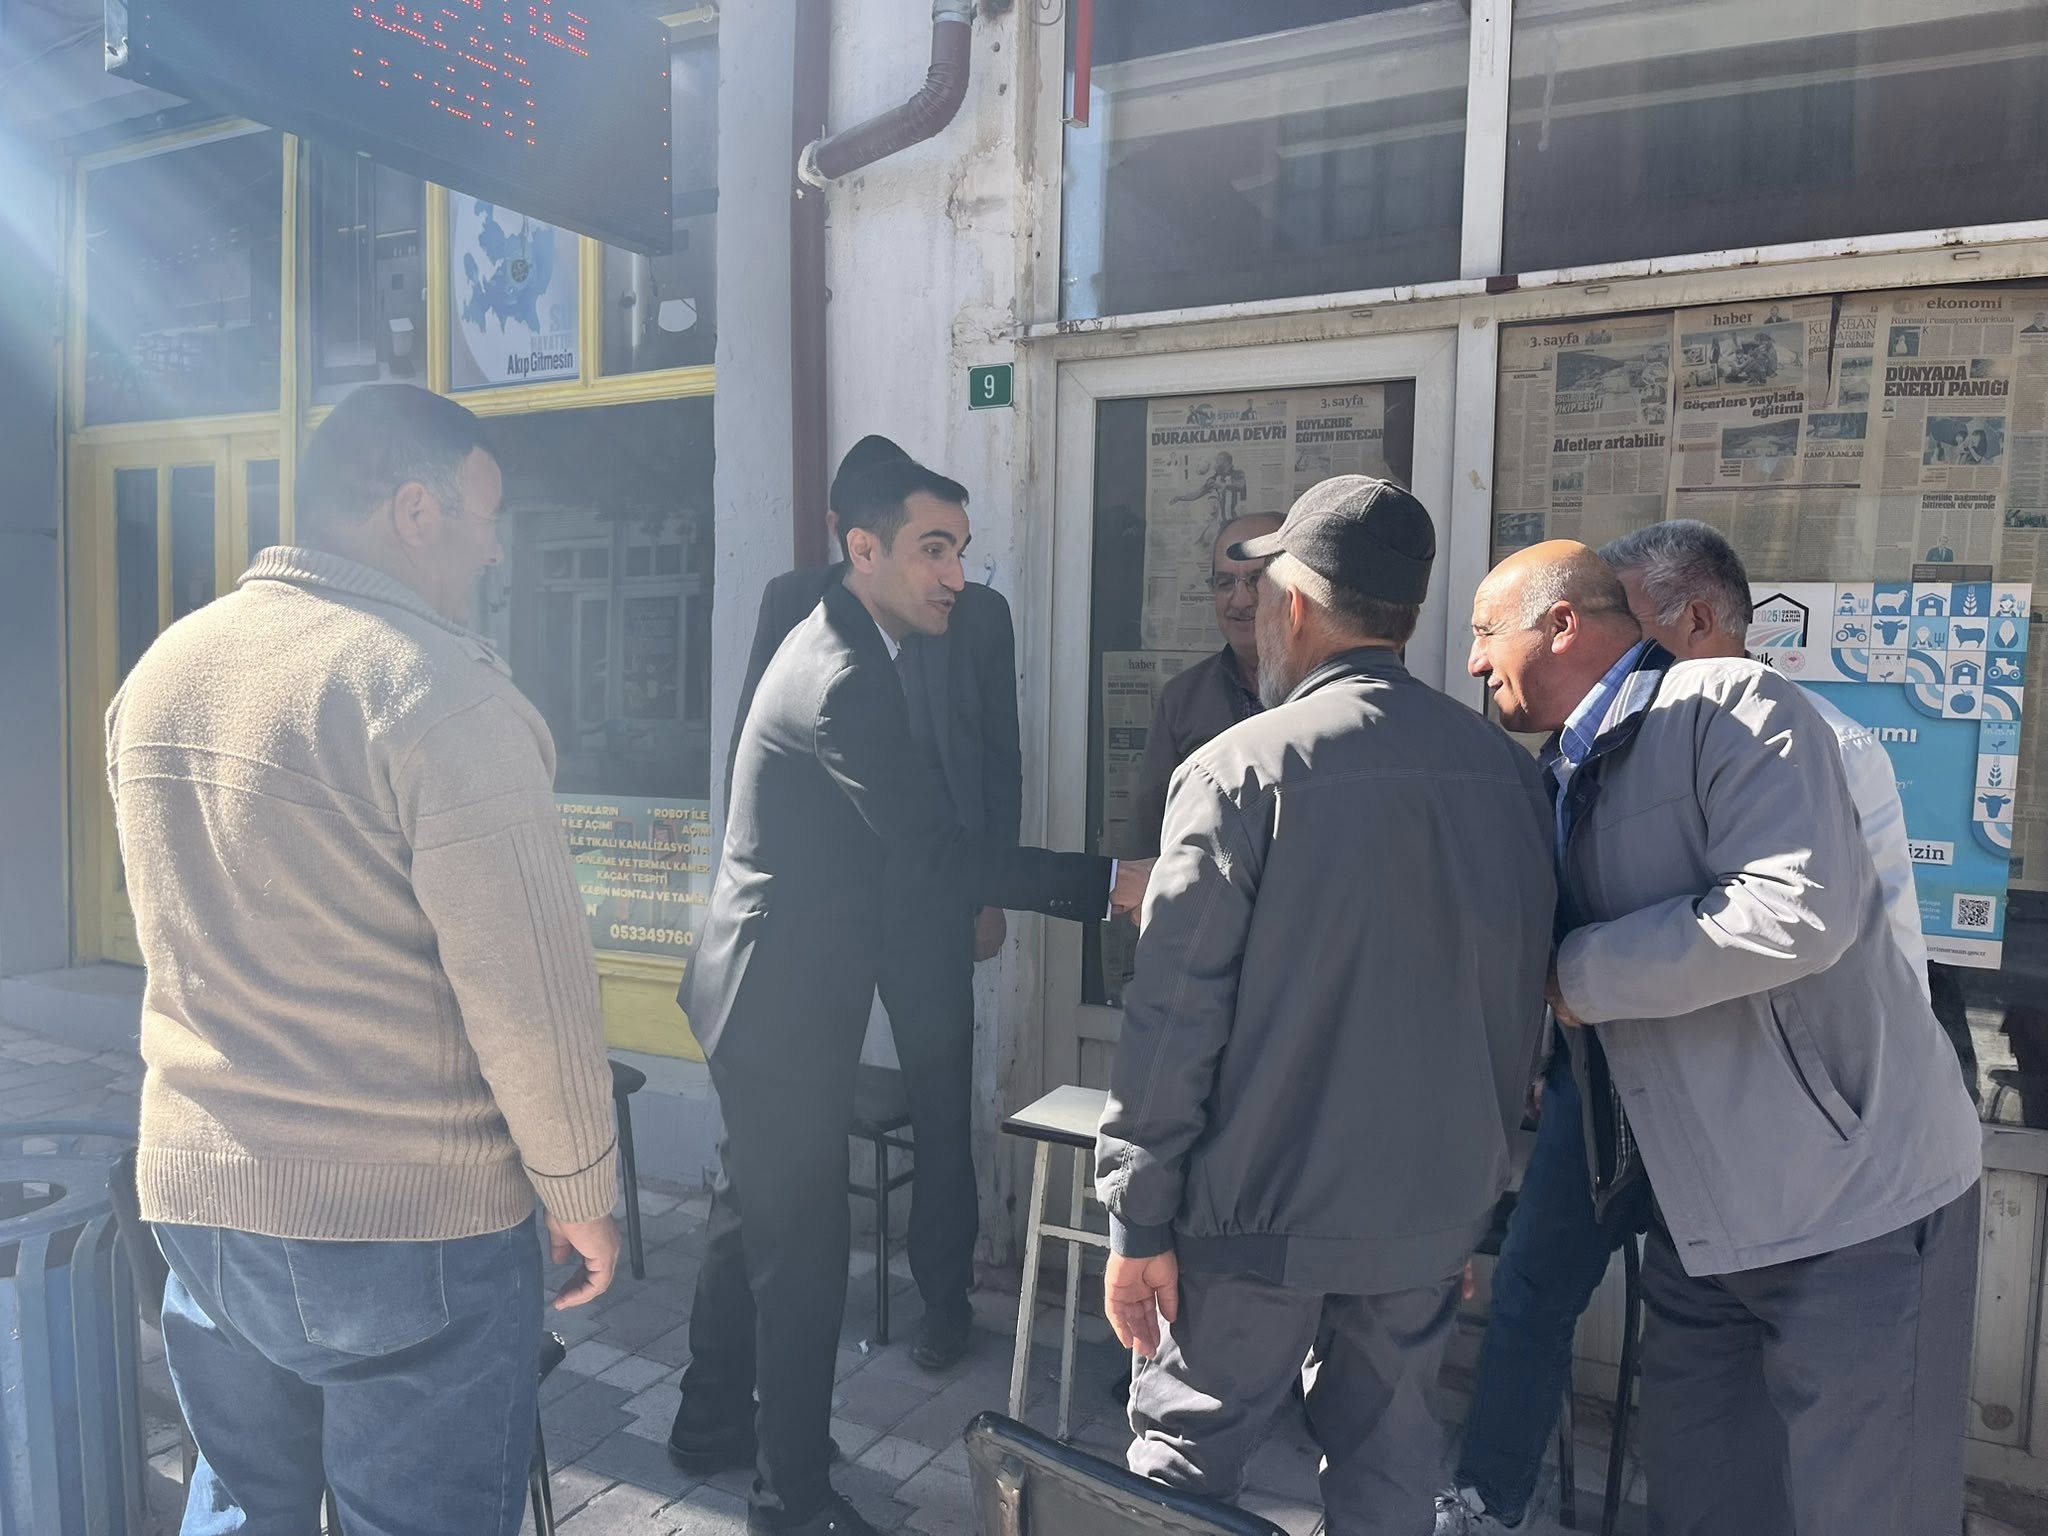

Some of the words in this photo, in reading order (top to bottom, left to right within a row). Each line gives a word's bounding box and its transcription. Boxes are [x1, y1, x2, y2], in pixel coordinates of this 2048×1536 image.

[1926, 296, 2002, 309] ekonomi
[1713, 312, 1753, 326] haber
[1543, 332, 1580, 348] sayfa
[507, 354, 530, 378] Akıp
[530, 349, 574, 372] Gitmesin
[1885, 365, 1967, 382] DÜNYADA
[984, 374, 994, 399] 9
[1884, 380, 1946, 397] ENERJİ
[1332, 394, 1364, 409] sayfa
[1683, 398, 1747, 411] Göçerlere
[1752, 402, 1803, 418] eğitimi
[1151, 428, 1242, 446] DURAKLAMA
[1243, 425, 1287, 441] DEVRİ
[1553, 438, 1602, 453] Afetler
[1604, 433, 1665, 449] artabilir
[1756, 609, 1778, 622] 2025
[1128, 658, 1157, 670] haber
[563, 804, 619, 816] BORULARIN
[654, 808, 690, 819] ROBOT
[691, 807, 709, 820] İLE
[618, 858, 632, 867] VE
[633, 859, 672, 870] TERMAL
[596, 871, 629, 882] KAÇAK
[632, 872, 668, 885] TESPİTİ
[611, 887, 655, 900] MONTAJ
[656, 891, 670, 902] VE
[609, 923, 694, 945] 053349760
